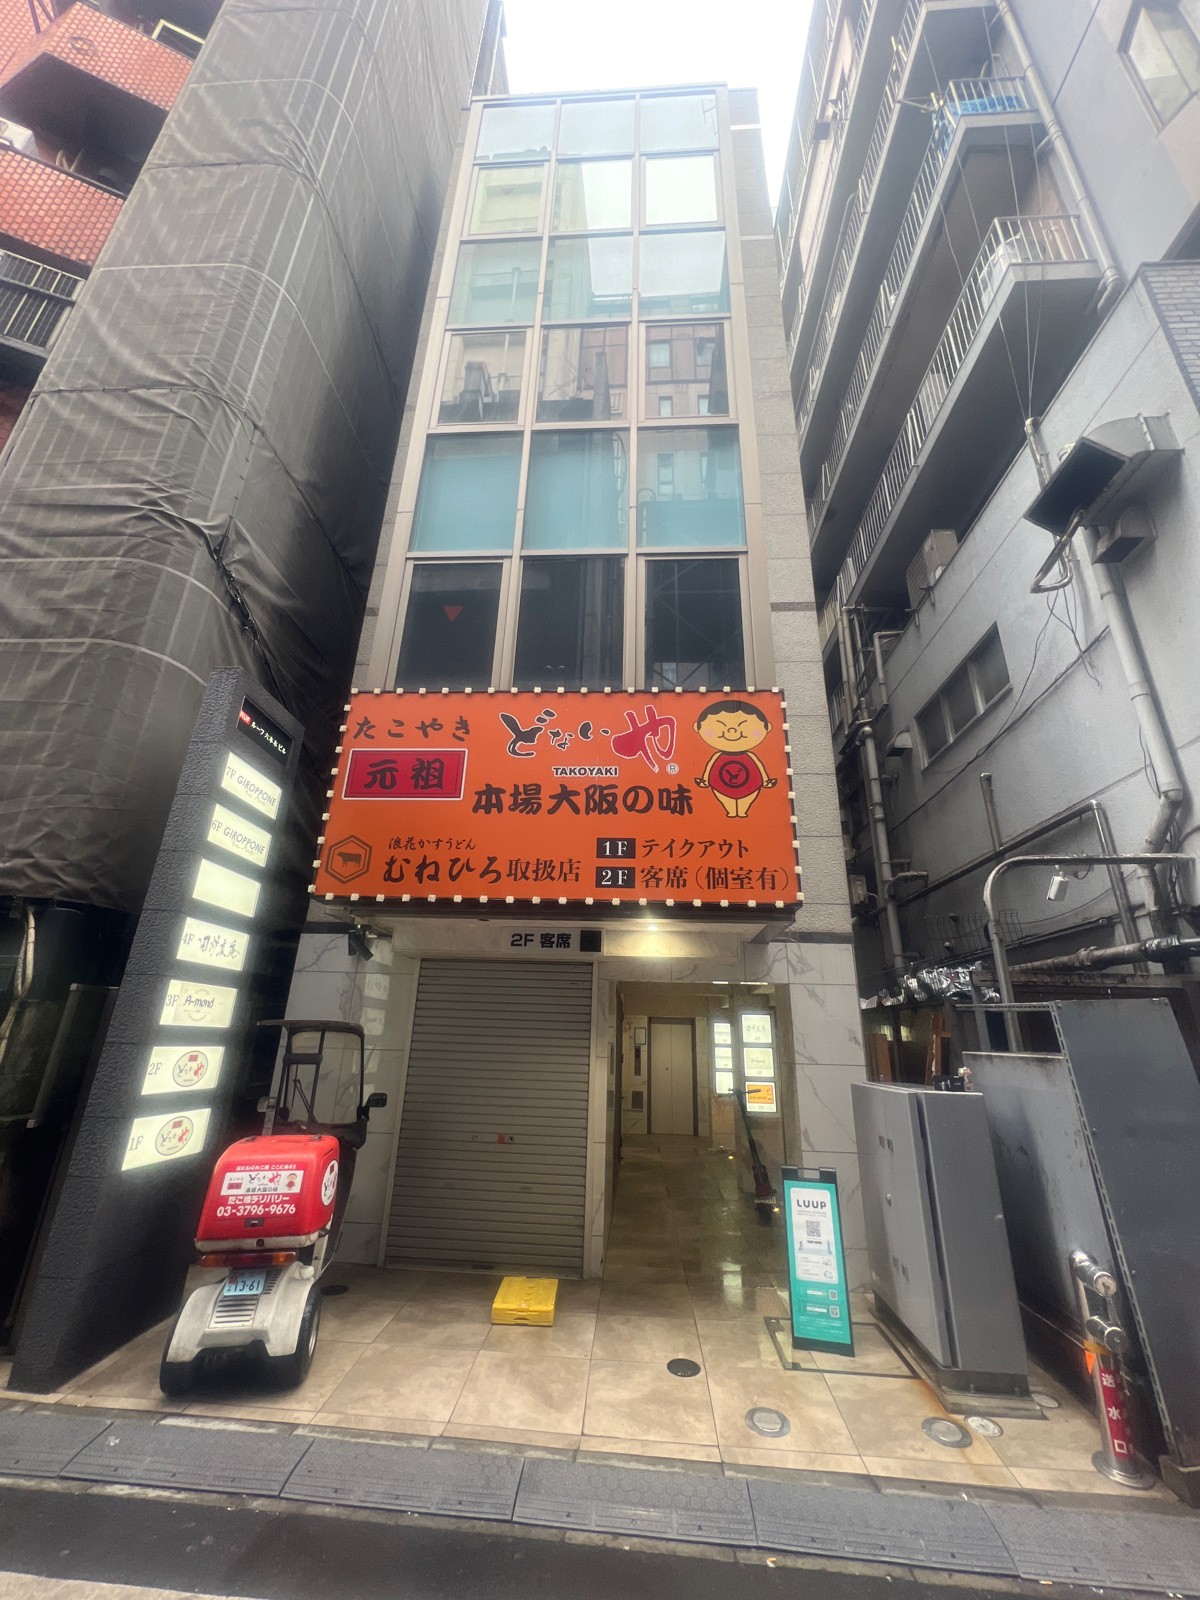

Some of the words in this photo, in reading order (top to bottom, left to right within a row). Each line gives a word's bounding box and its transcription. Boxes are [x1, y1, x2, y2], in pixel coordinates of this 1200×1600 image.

[354, 716, 470, 742] たこやき
[499, 705, 676, 774] どないや
[364, 757, 444, 790] 元祖
[553, 766, 618, 776] TAKOYAKI
[226, 767, 236, 779] 7F
[237, 775, 276, 806] GIROPPONE
[472, 783, 693, 815] 本場大阪の味
[211, 819, 223, 832] 6F
[223, 827, 265, 854] GIROPPONE
[388, 836, 477, 850] 浪花かすうどん
[603, 841, 628, 855] 1F
[641, 839, 749, 858] テイクアウト
[601, 869, 628, 885] 2F
[182, 933, 195, 945] 4F
[511, 933, 535, 946] 2F
[540, 933, 571, 948] 客席
[165, 994, 179, 1007] 3F
[148, 1062, 162, 1075] 2F
[128, 1135, 144, 1152] 1F
[217, 1204, 296, 1217] 03-3796-9676
[796, 1199, 827, 1210] LUUP
